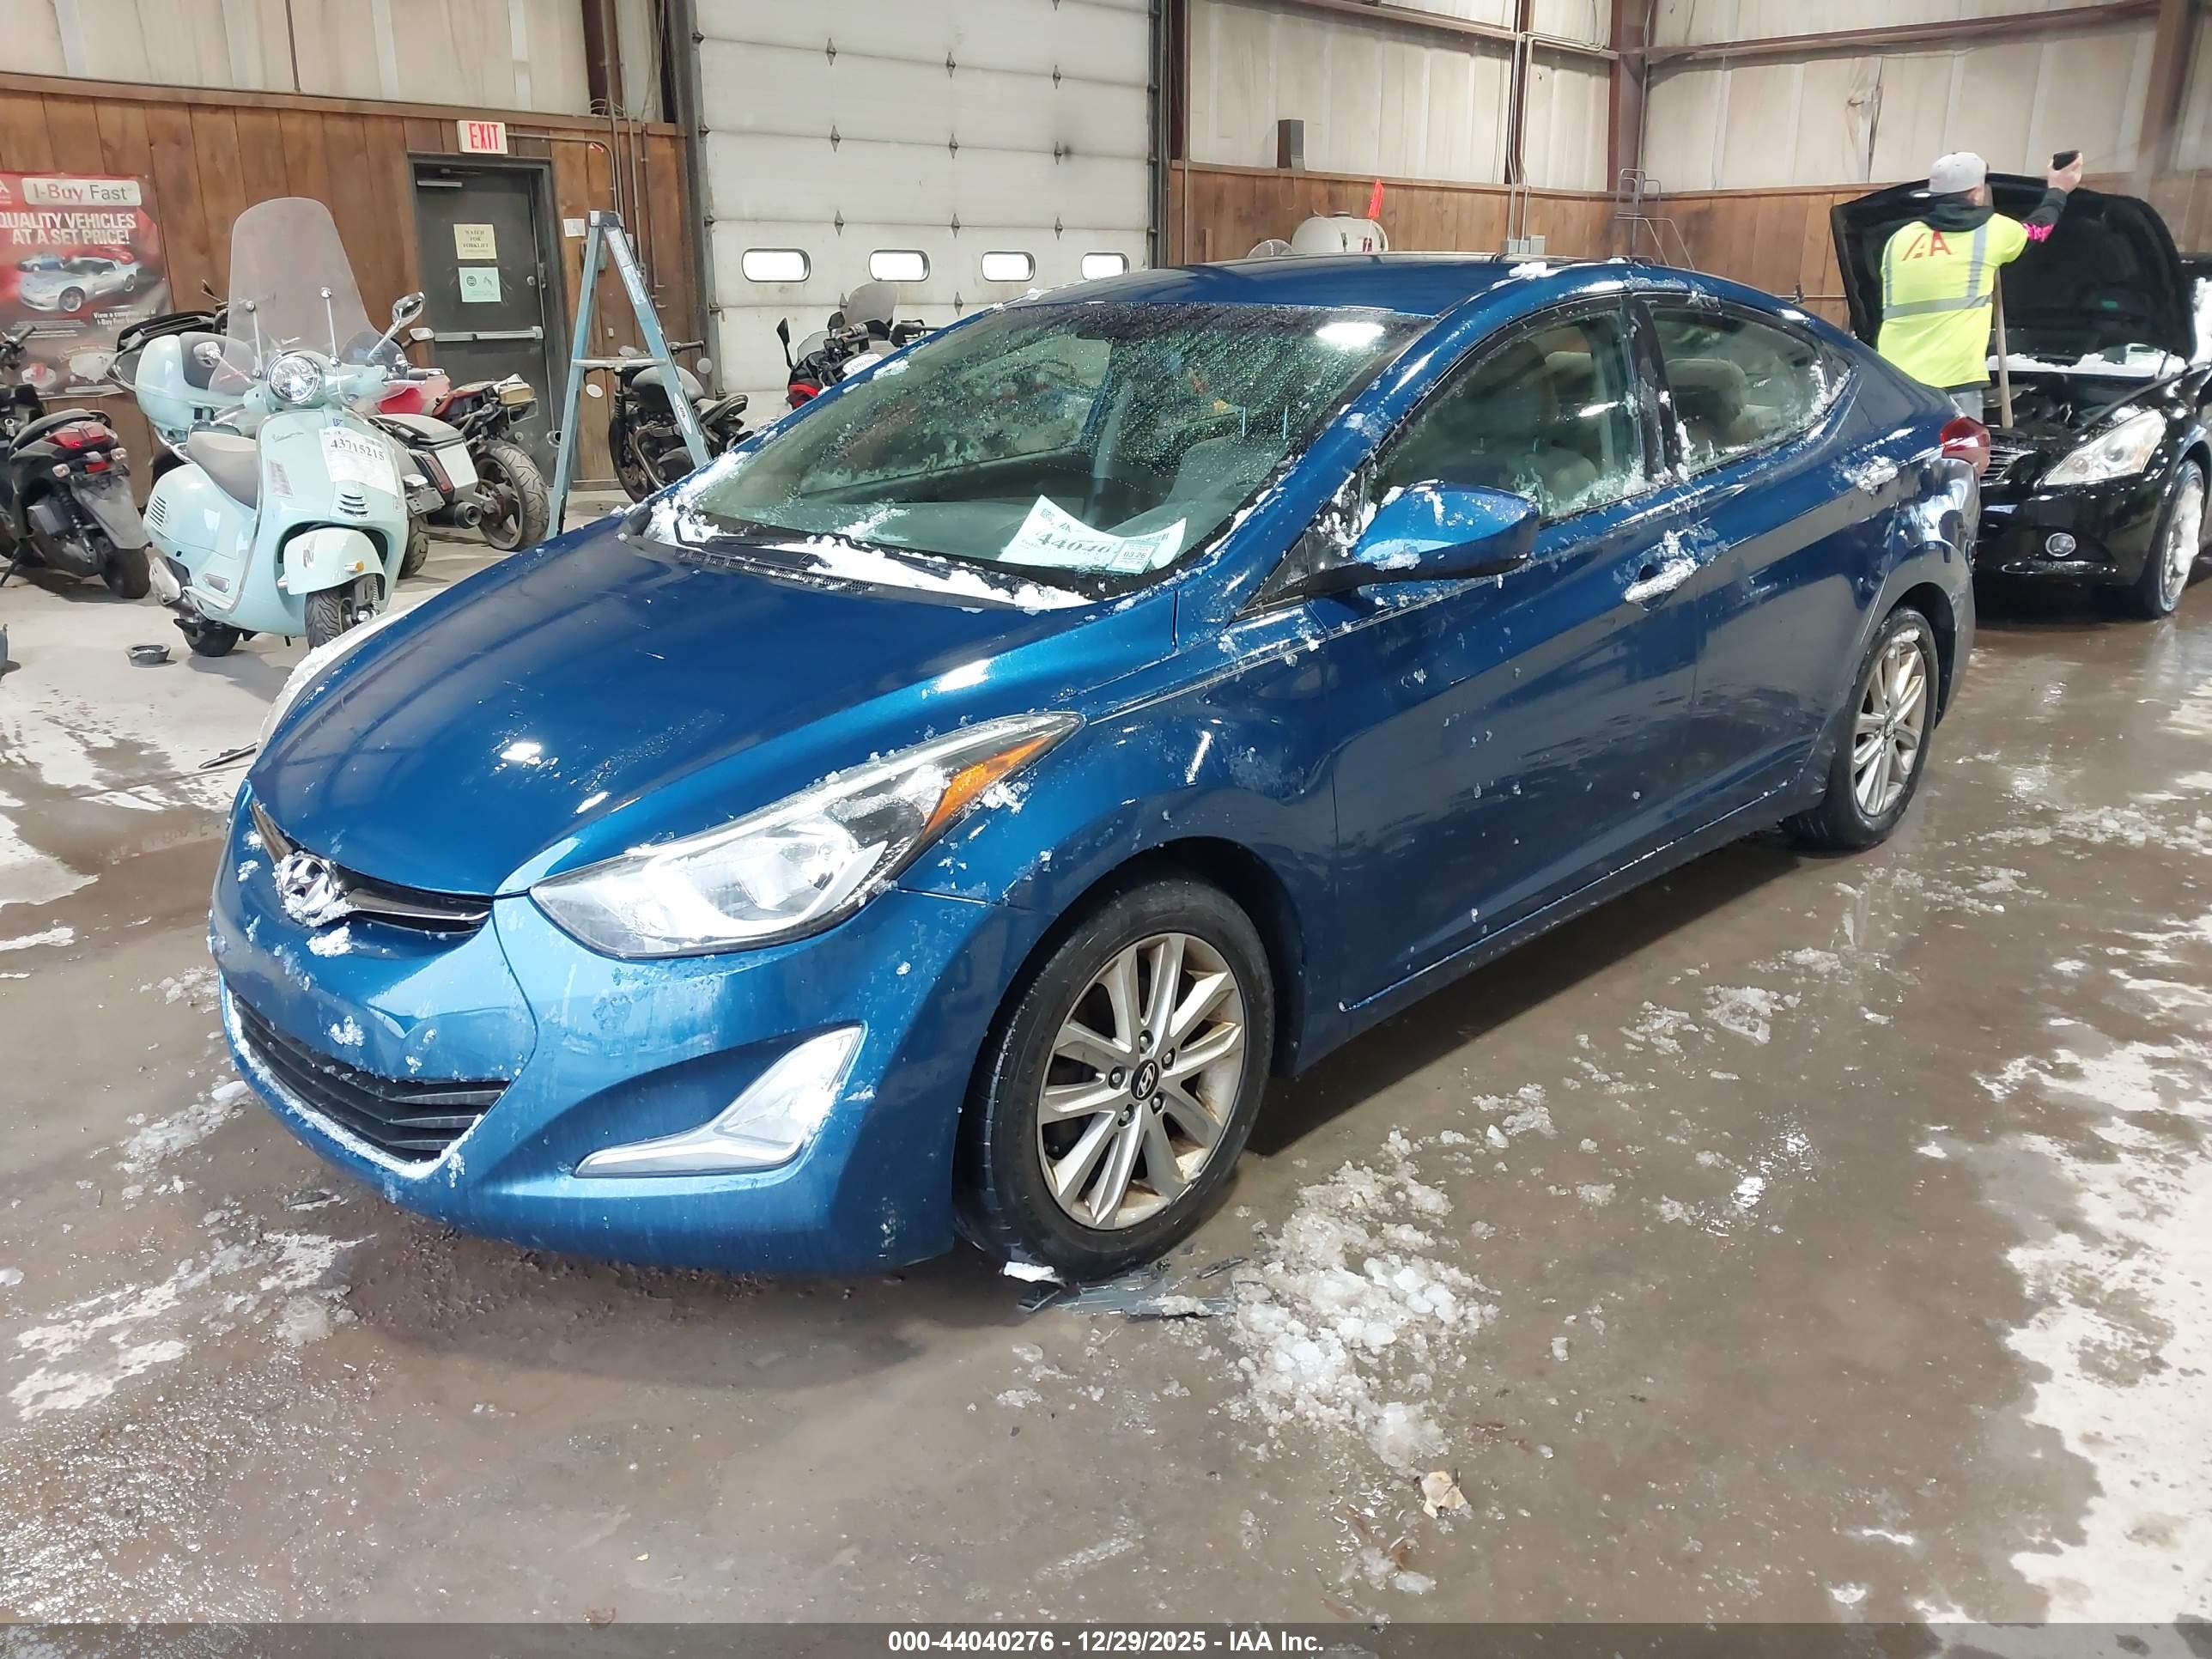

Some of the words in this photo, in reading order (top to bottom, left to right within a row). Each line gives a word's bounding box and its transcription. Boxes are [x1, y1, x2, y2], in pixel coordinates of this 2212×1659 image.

[468, 123, 498, 150] EXIT
[33, 183, 83, 203] I-Buy
[89, 184, 128, 200] Fast
[0, 212, 63, 228] QUALITY
[64, 213, 137, 228] VEHICLES
[12, 229, 33, 245] AT
[37, 229, 50, 245] A
[50, 228, 81, 245] SET
[82, 229, 131, 245] PRICE!
[330, 438, 386, 462] 43715215
